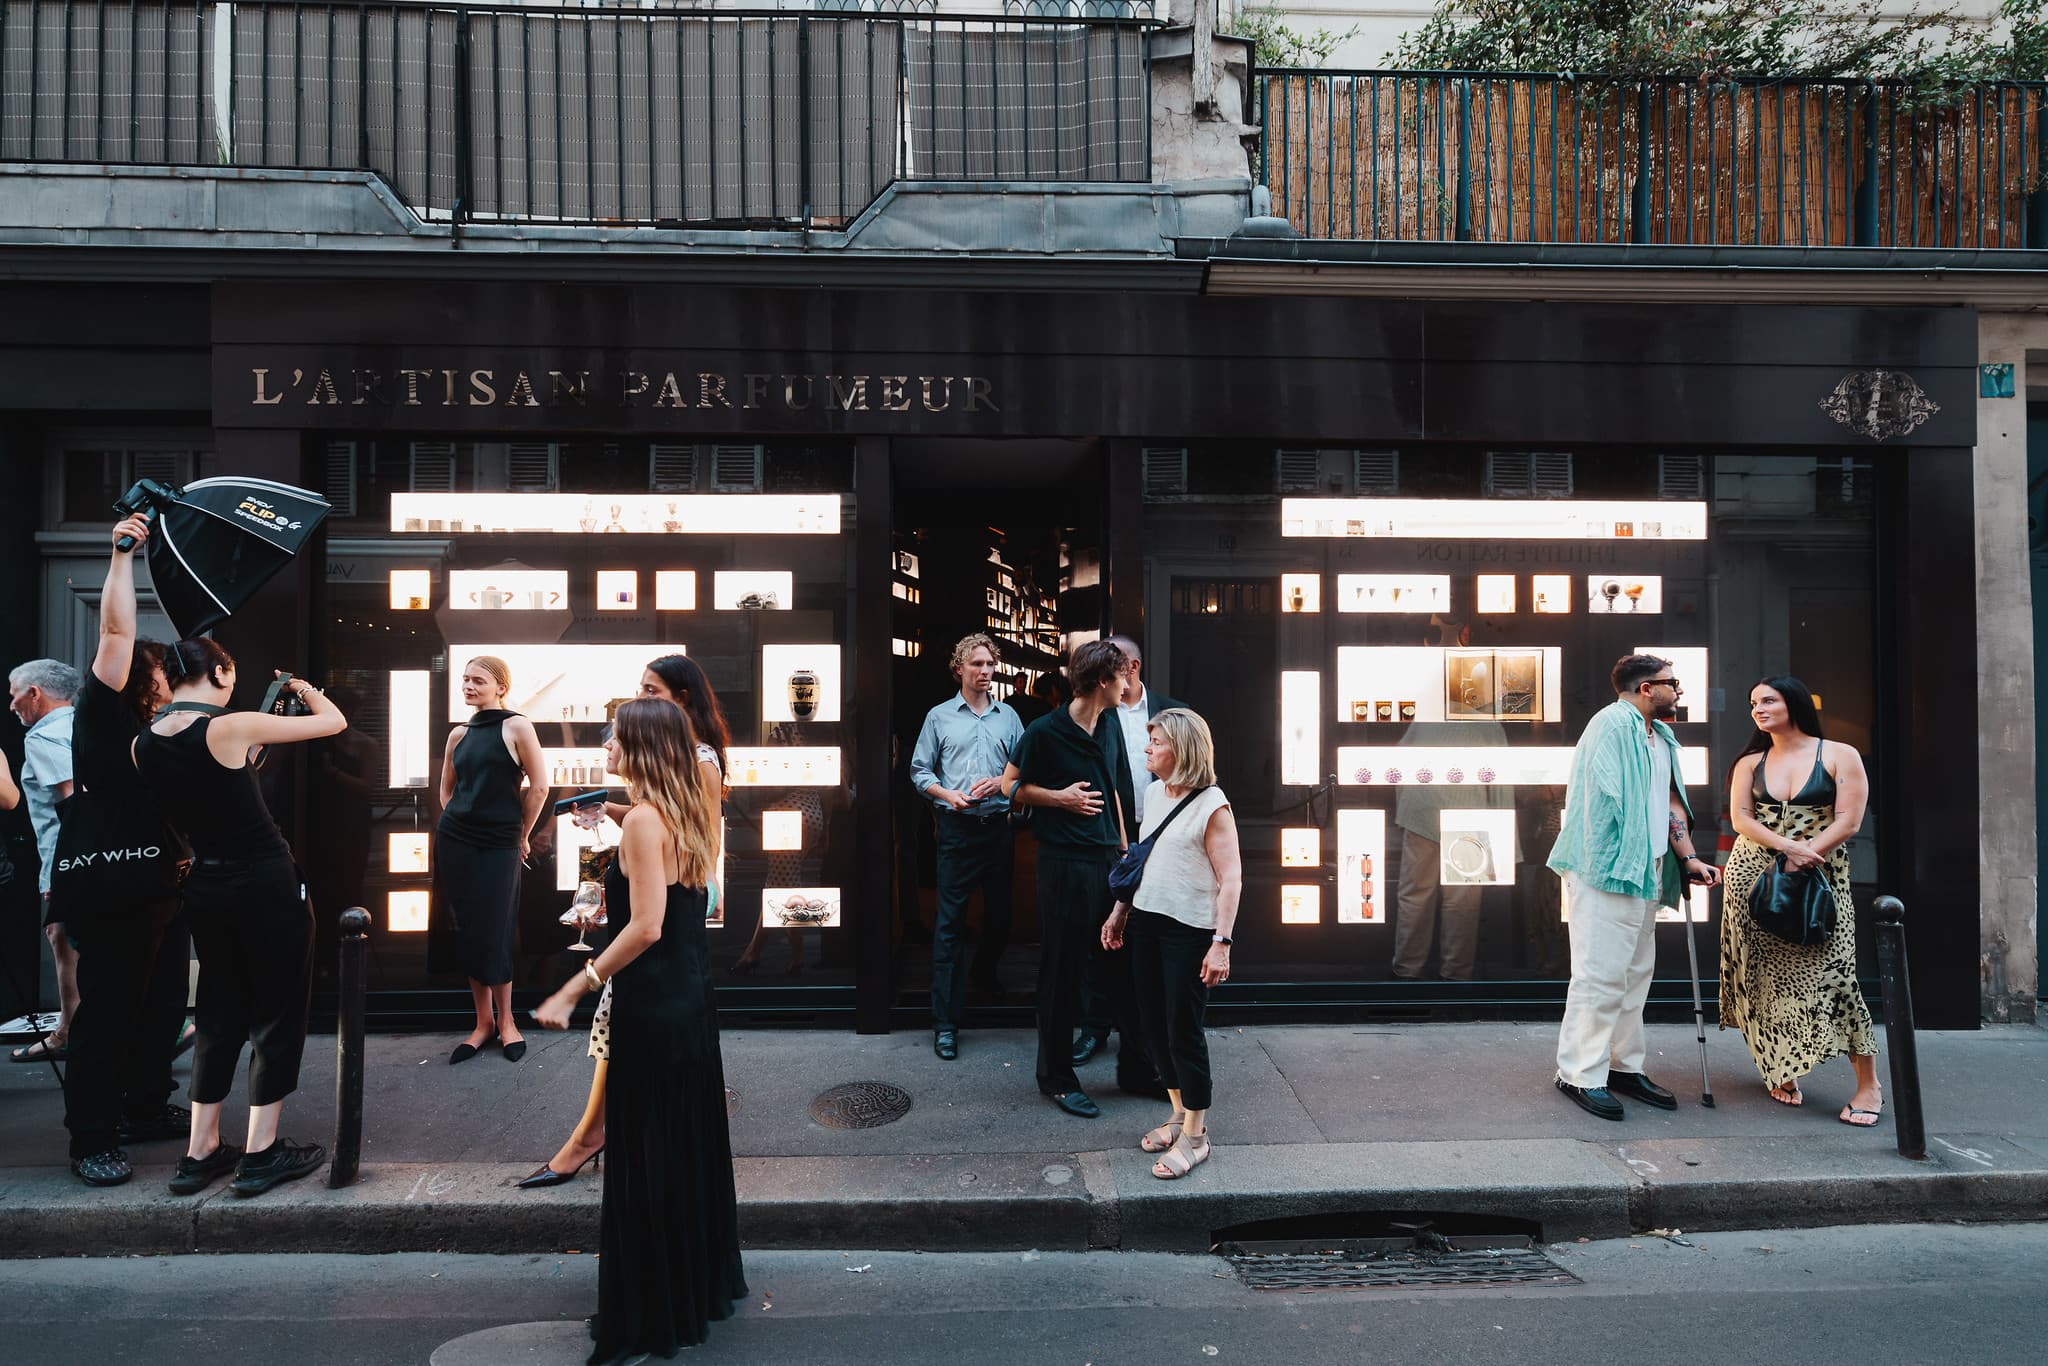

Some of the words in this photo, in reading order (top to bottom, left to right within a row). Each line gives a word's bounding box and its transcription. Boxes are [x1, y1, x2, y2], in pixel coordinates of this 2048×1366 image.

[250, 367, 591, 408] L'ARTISAN
[621, 370, 1001, 413] PARFUMEUR
[233, 508, 284, 532] SPEEDBOX
[239, 501, 276, 519] FLIP
[58, 852, 98, 872] SAY
[102, 846, 161, 864] WHO
